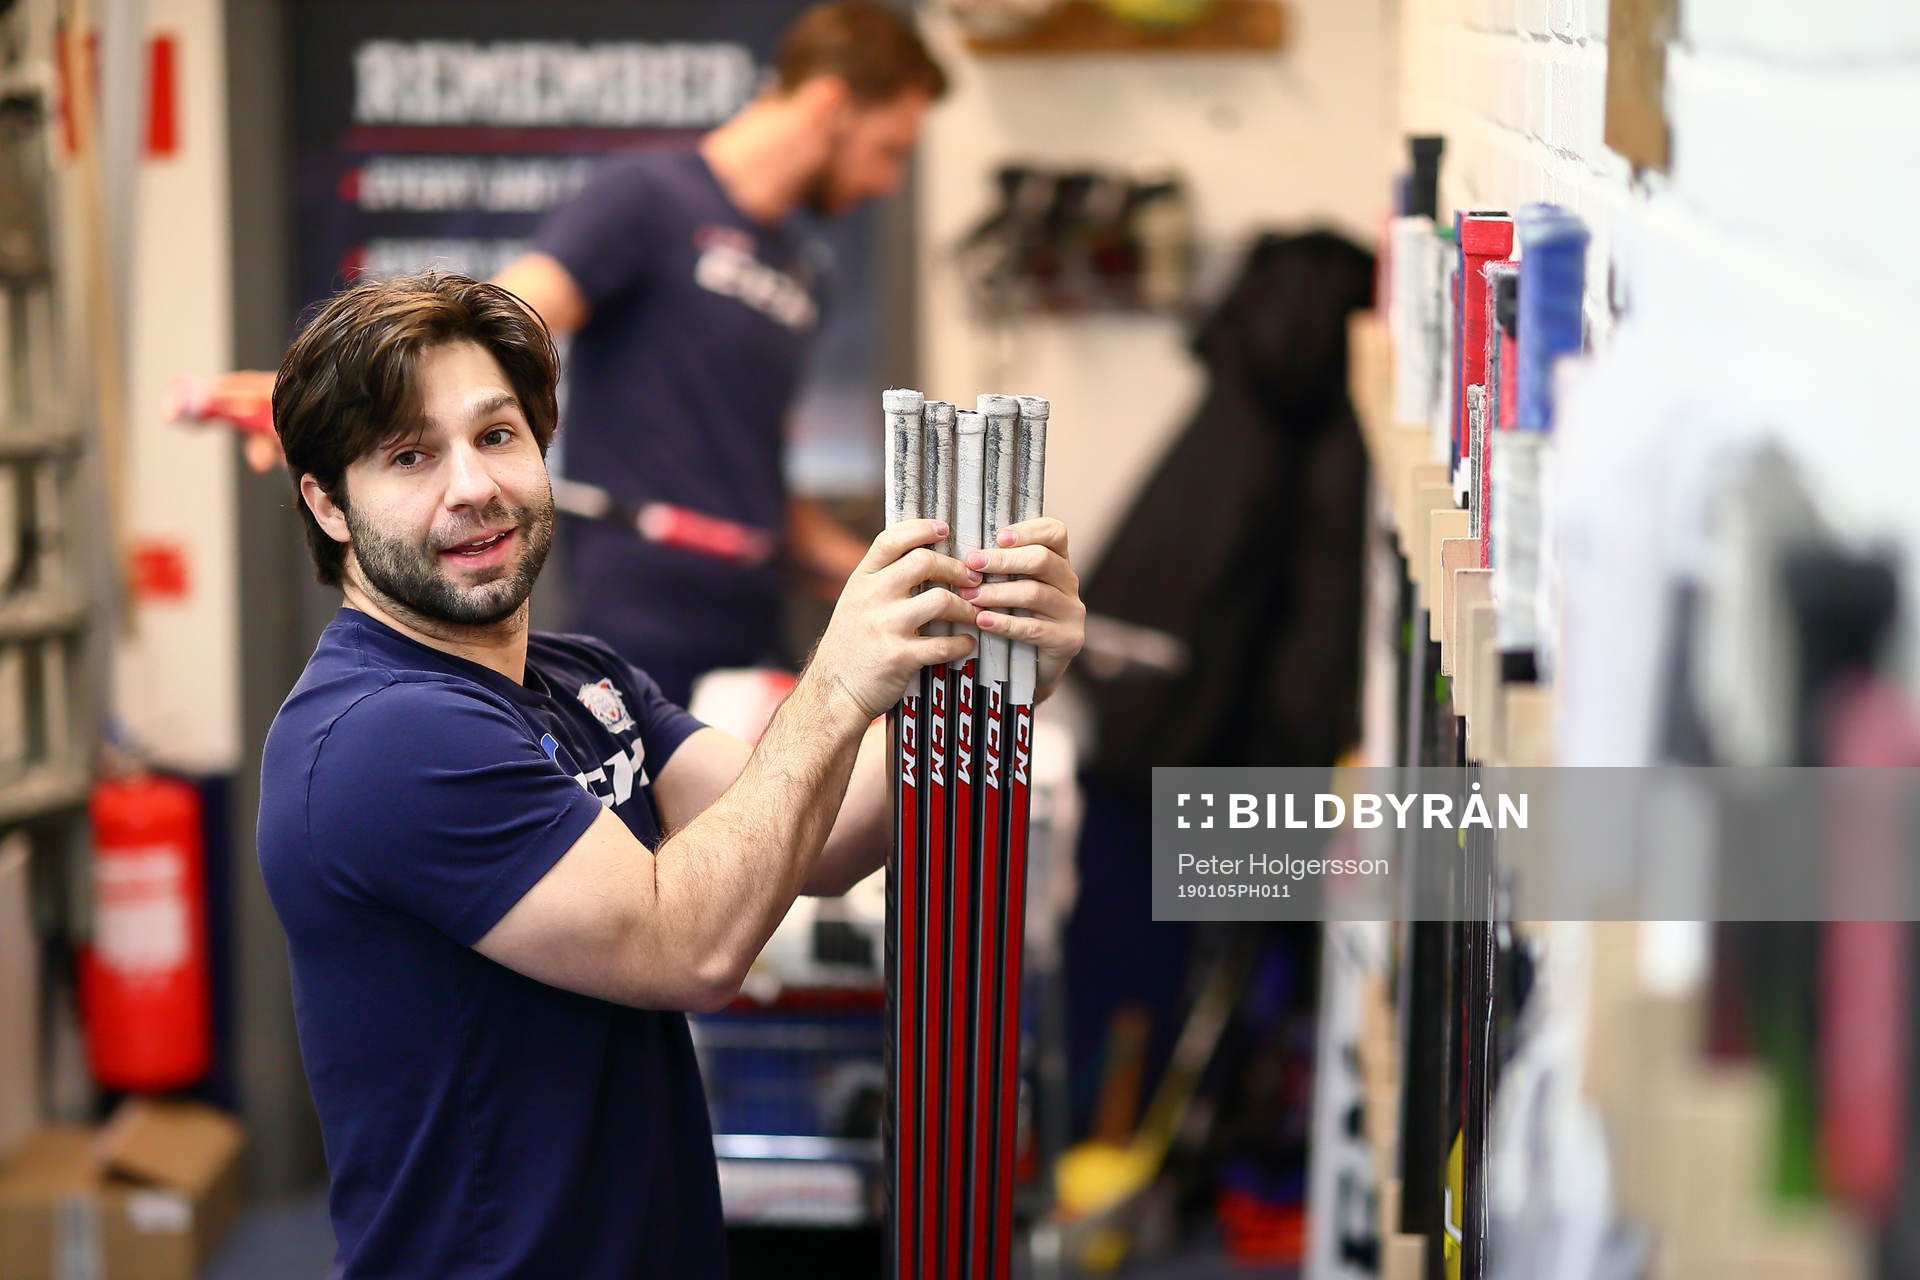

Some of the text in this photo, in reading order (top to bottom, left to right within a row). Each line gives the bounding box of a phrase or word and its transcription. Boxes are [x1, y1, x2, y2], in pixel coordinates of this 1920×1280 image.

[932, 676, 945, 786] CCM
[958, 675, 973, 785] CCM
[986, 681, 1001, 790] CCM
[1015, 704, 1030, 786] CM
